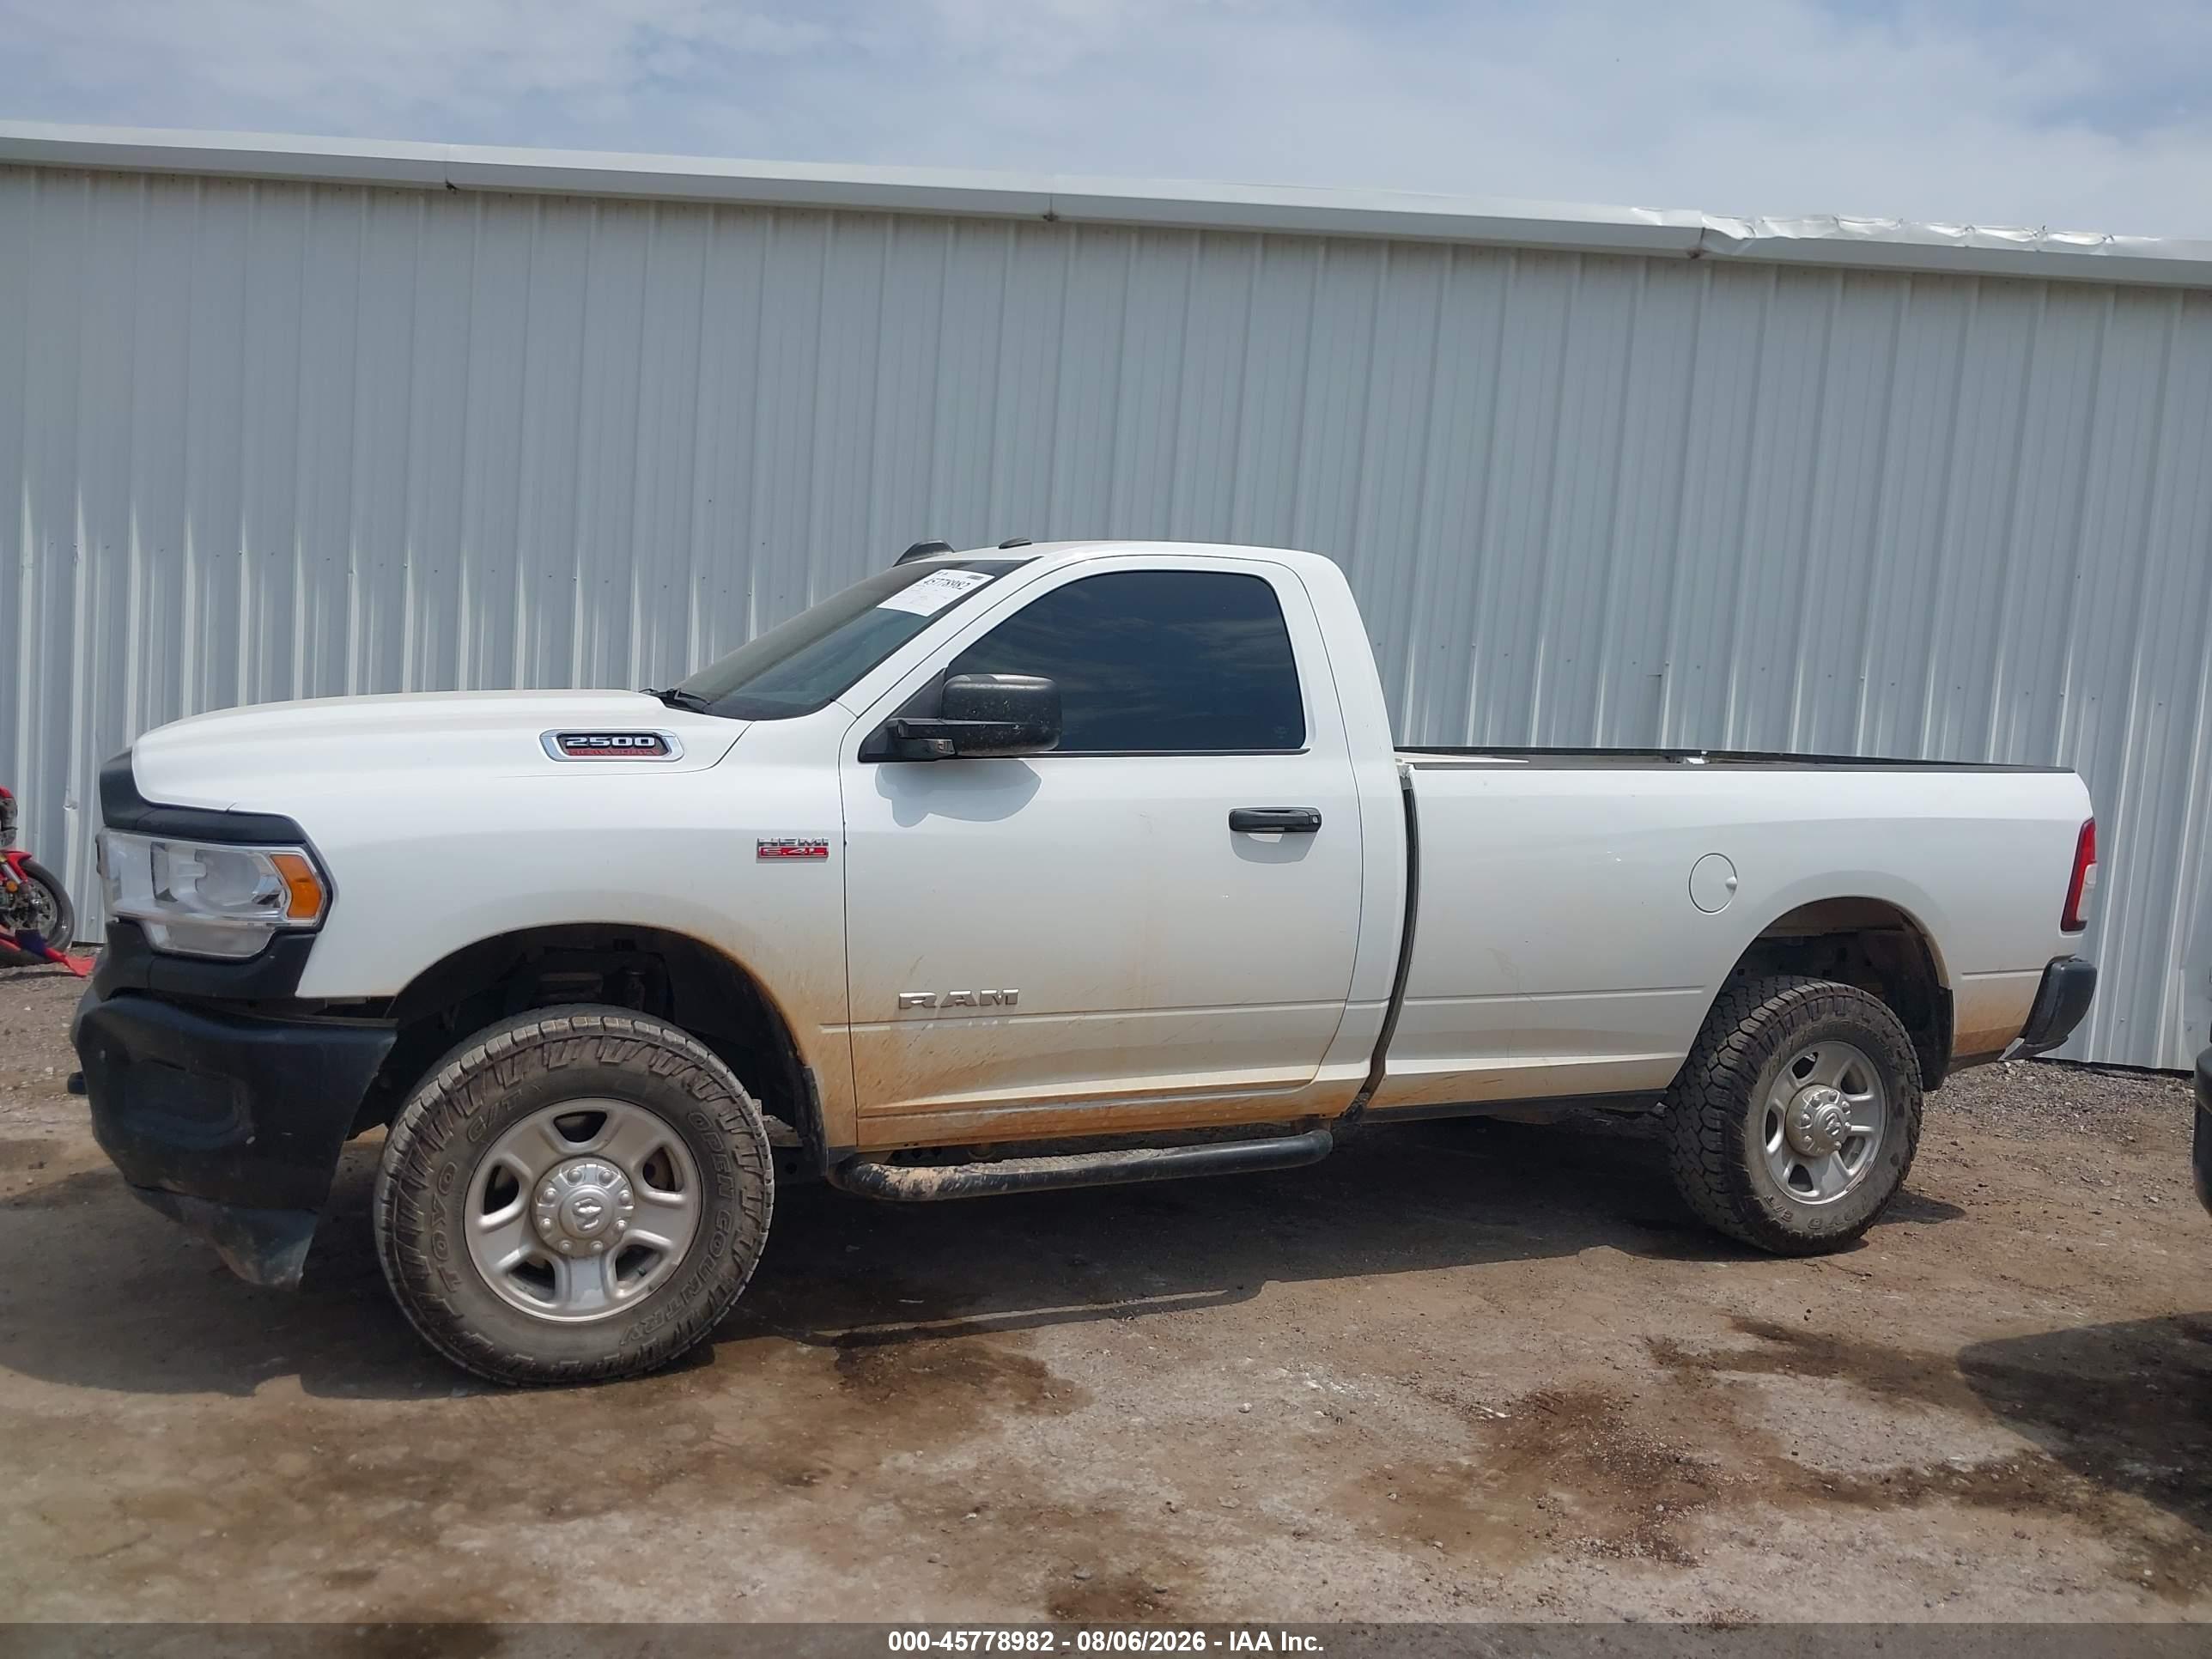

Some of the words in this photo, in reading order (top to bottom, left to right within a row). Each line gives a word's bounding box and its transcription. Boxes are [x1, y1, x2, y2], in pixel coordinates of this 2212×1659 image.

[565, 736, 656, 747] 2500
[757, 837, 830, 847] HEMI
[898, 988, 1019, 1010] RAM
[687, 1111, 736, 1200] OPEN
[431, 1161, 462, 1293] TOYO
[619, 1209, 731, 1346] COUNTRY
